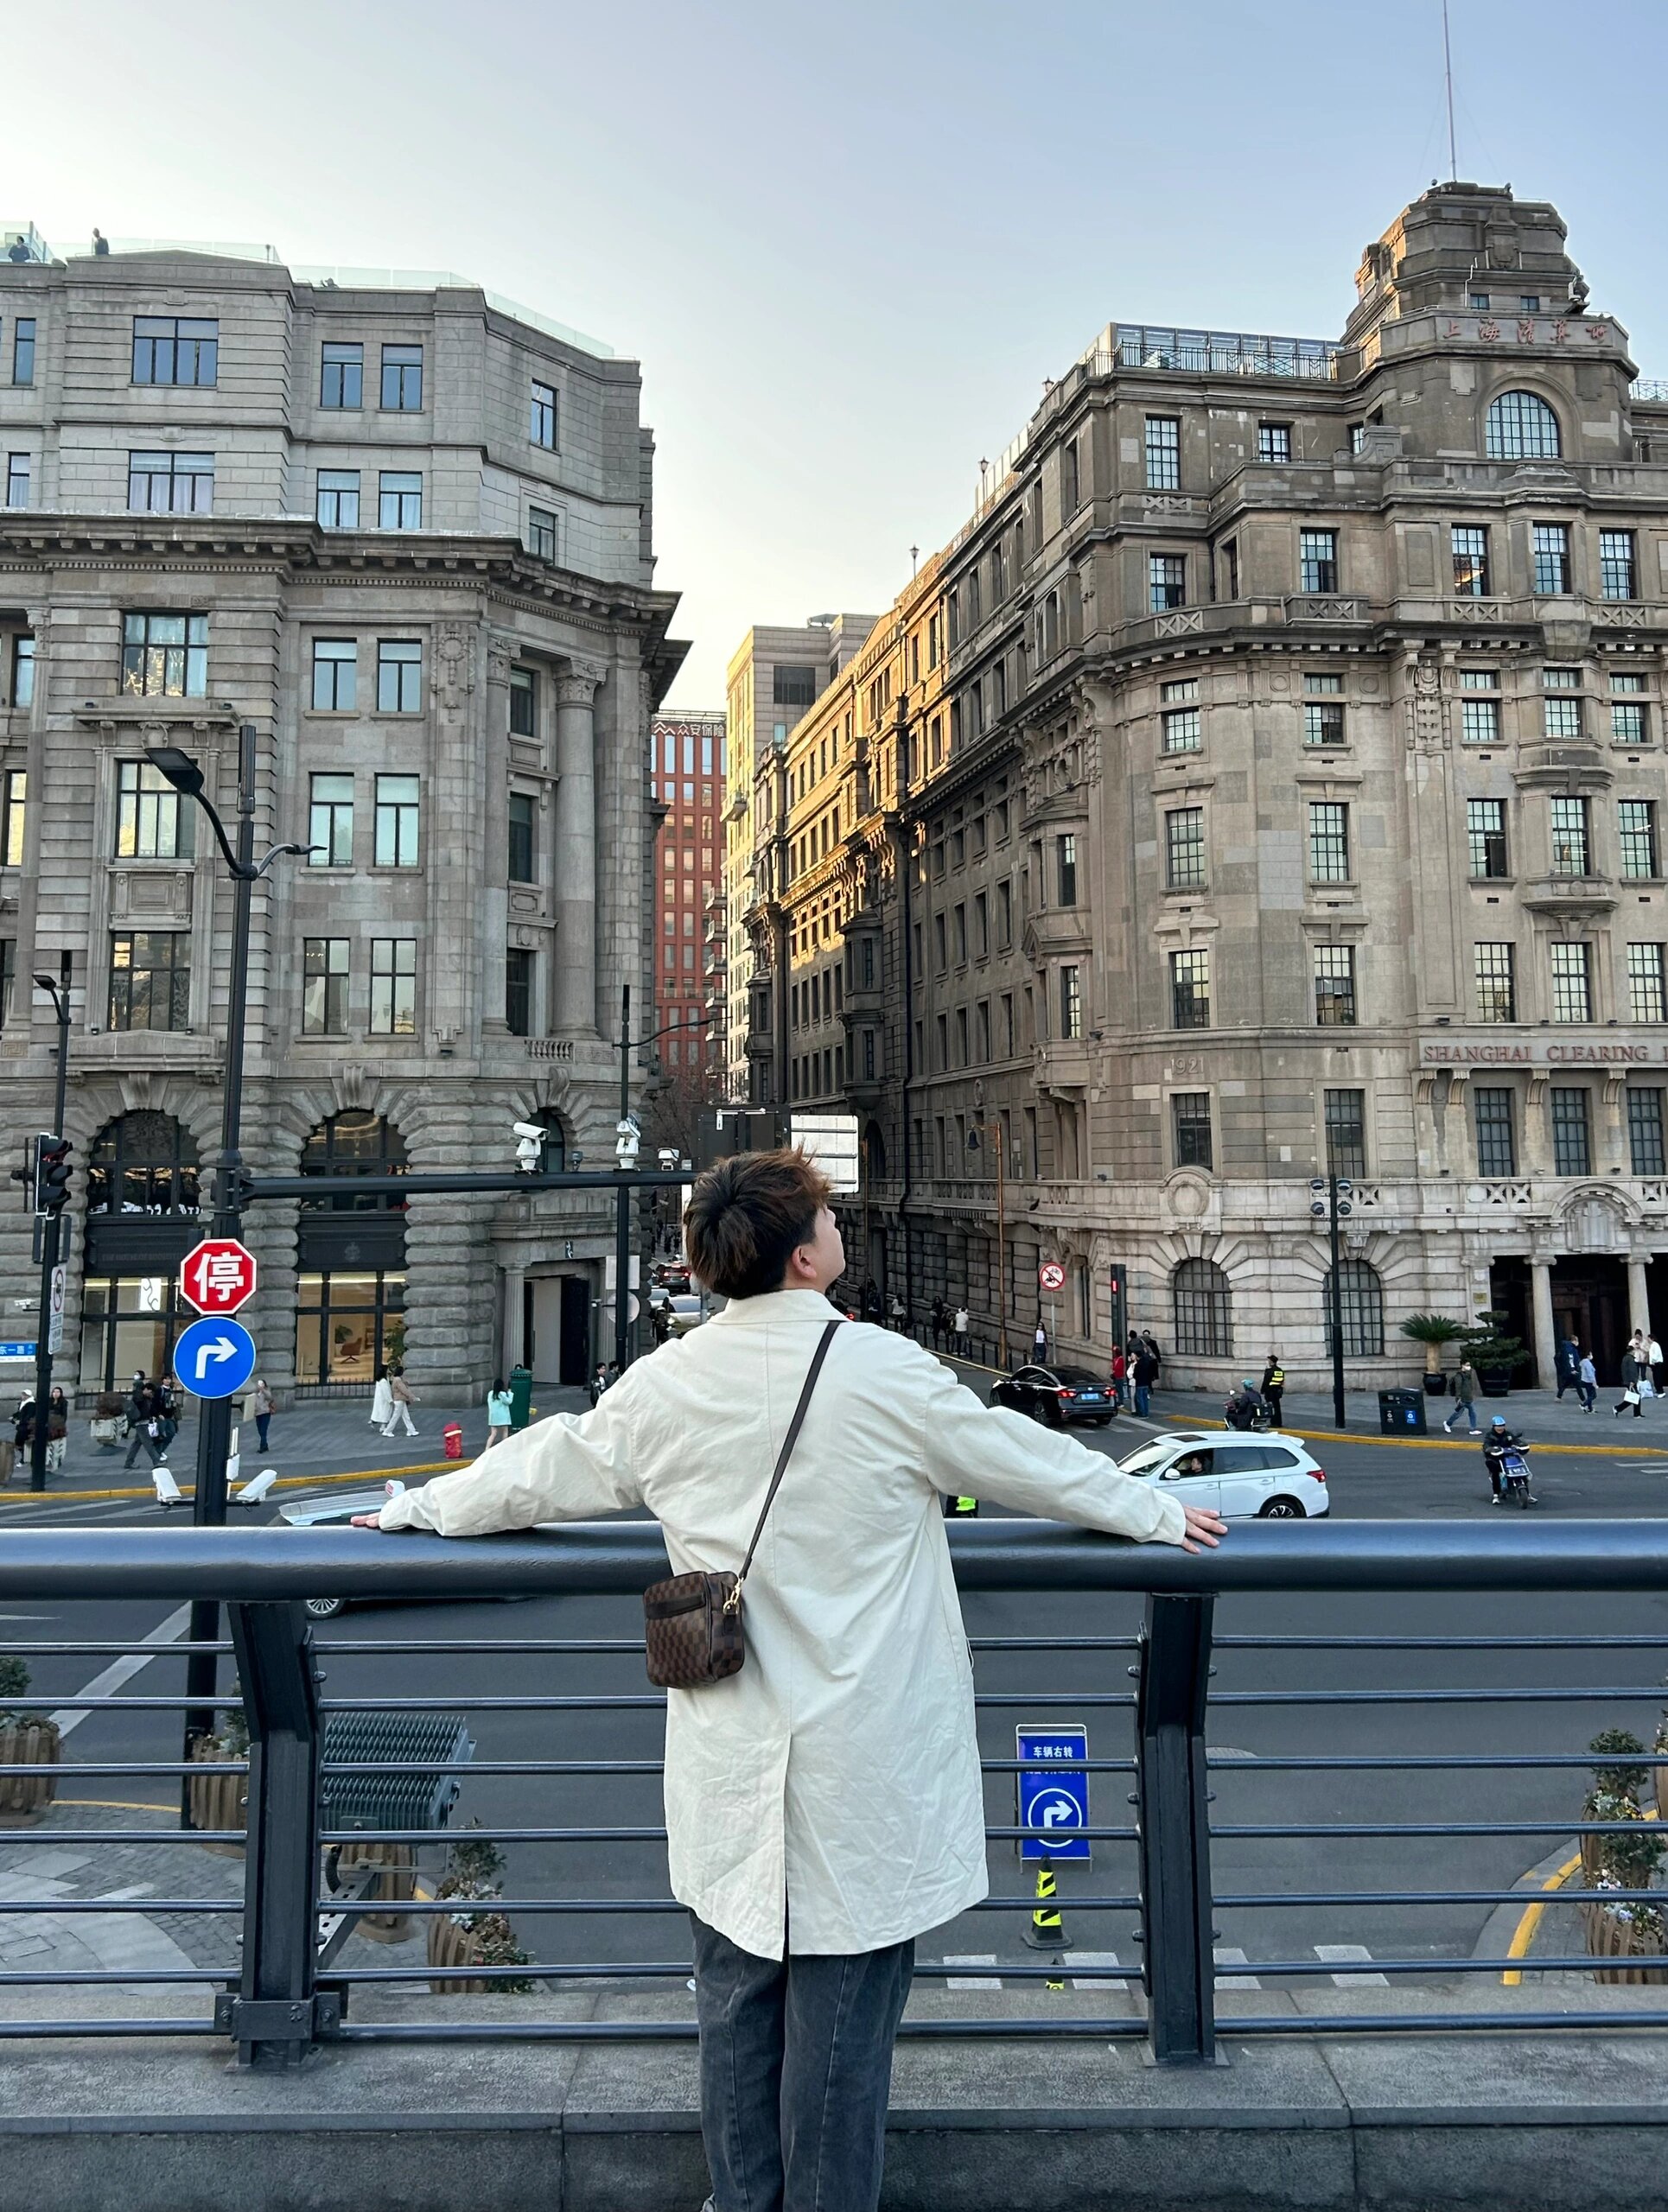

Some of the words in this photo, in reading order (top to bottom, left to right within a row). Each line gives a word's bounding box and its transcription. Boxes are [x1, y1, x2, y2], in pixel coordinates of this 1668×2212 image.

[677, 723, 724, 737] 众安保险
[1424, 1046, 1532, 1062] SHANGHAI
[1546, 1046, 1648, 1062] CLEARING
[1170, 1057, 1204, 1075] 1921
[193, 1251, 245, 1303] 停
[1033, 1745, 1073, 1758] 车辆右转
